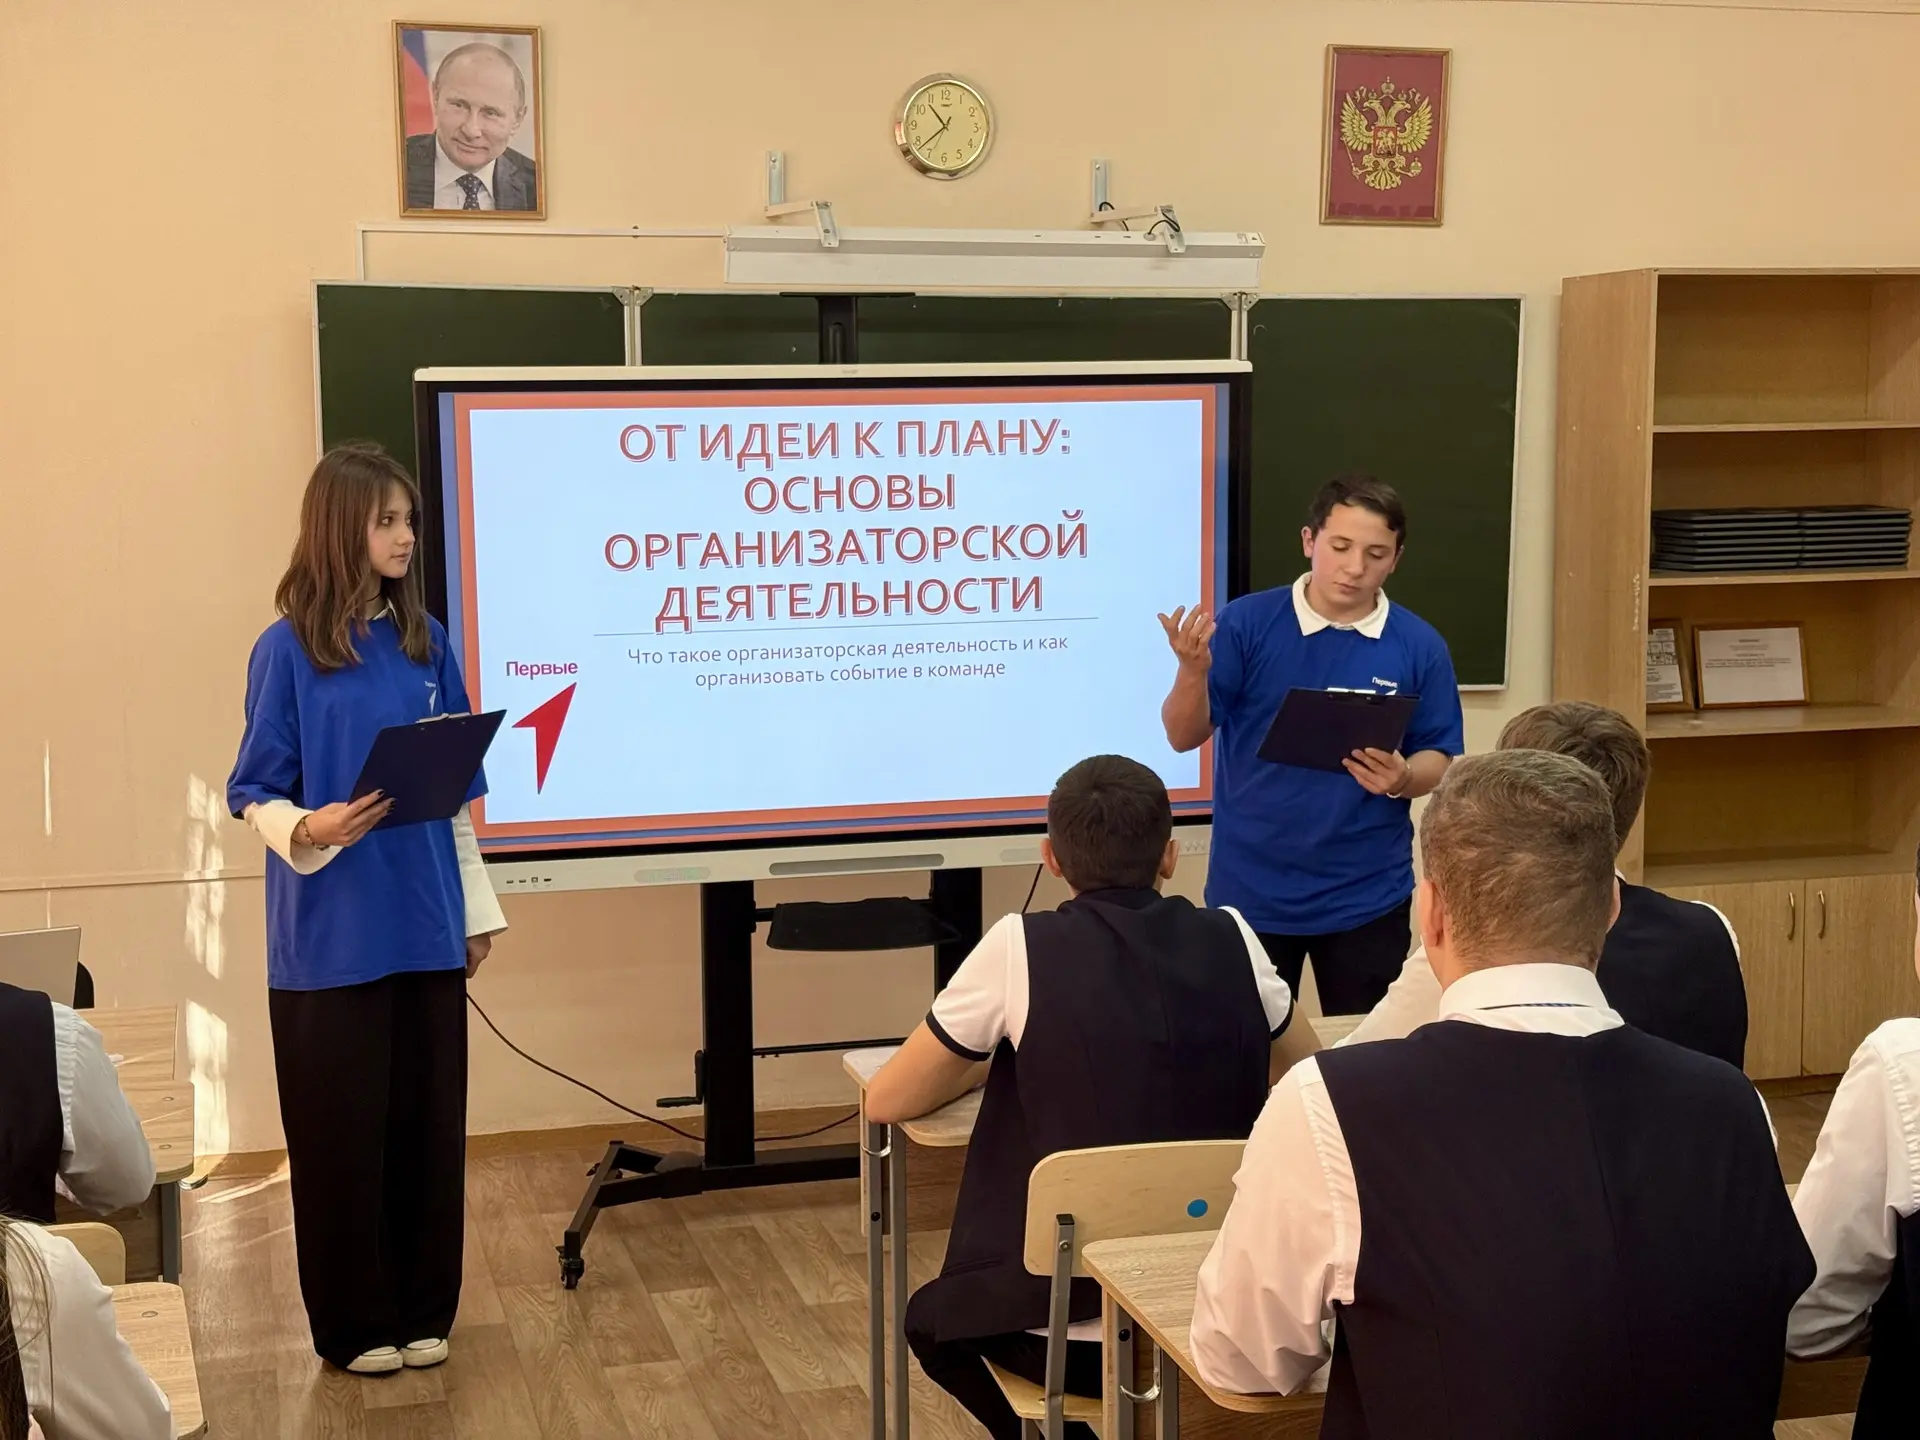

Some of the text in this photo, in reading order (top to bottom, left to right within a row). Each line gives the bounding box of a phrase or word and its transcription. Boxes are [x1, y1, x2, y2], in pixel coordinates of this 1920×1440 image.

[928, 93, 934, 103] 11
[941, 89, 951, 100] 12
[916, 104, 926, 115] 10
[969, 106, 976, 117] 2
[910, 120, 917, 130] 9
[973, 123, 979, 133] 3
[967, 138, 973, 148] 4
[926, 148, 932, 158] 7
[941, 153, 947, 163] 6
[956, 149, 962, 160] 5
[620, 418, 1071, 472] ОТ ИДЕИ К ПЛАНУ:
[744, 474, 955, 514] ОСНОВЫ
[604, 510, 1087, 572] ОРГАНИЗАТОРСКОЙ
[655, 576, 1043, 634] ДЕЯТЕЛЬНОСТИ
[628, 636, 1068, 666] Что такое организаторская деятельность и как
[506, 661, 578, 680] Первые
[695, 662, 1006, 690] организовать событие в команде
